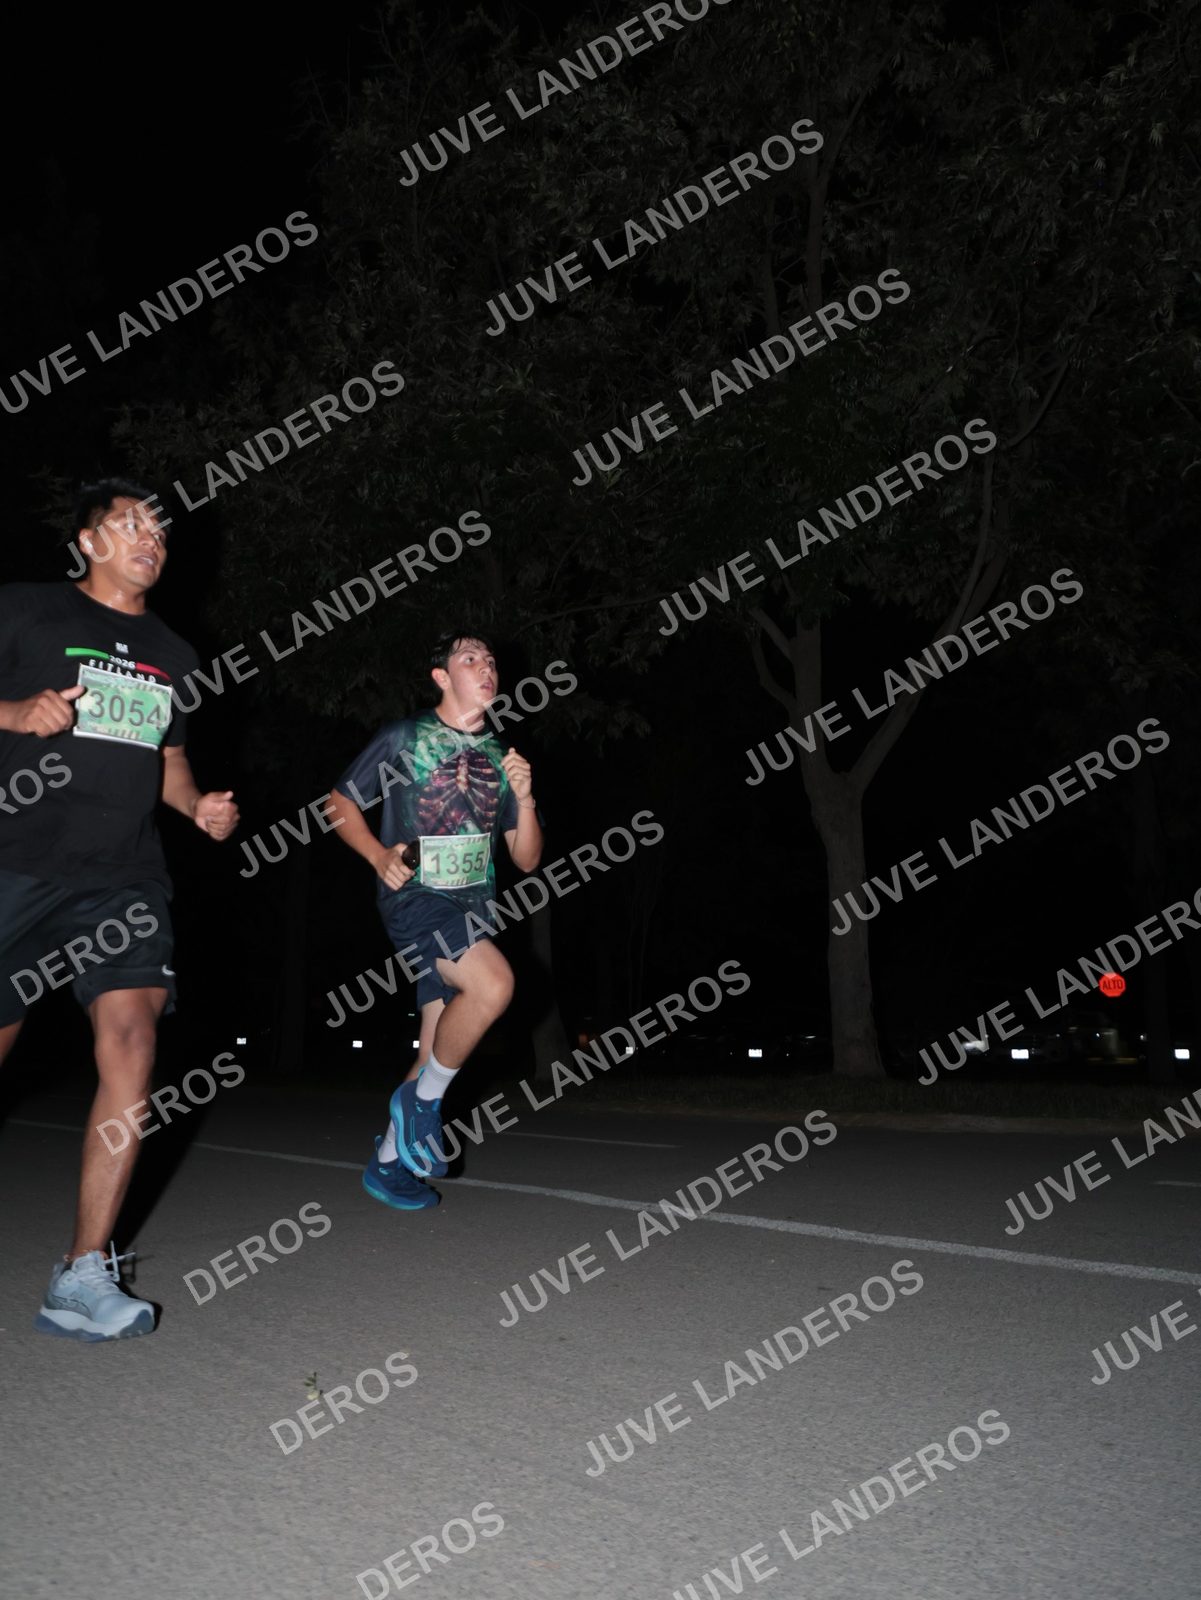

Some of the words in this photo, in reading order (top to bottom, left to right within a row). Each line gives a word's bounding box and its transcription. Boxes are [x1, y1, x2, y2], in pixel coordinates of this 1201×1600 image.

[88, 659, 156, 683] FITLAND
[110, 655, 136, 670] 2026
[88, 689, 162, 730] 3054
[430, 851, 484, 874] 1355
[1102, 978, 1124, 990] ALTO
